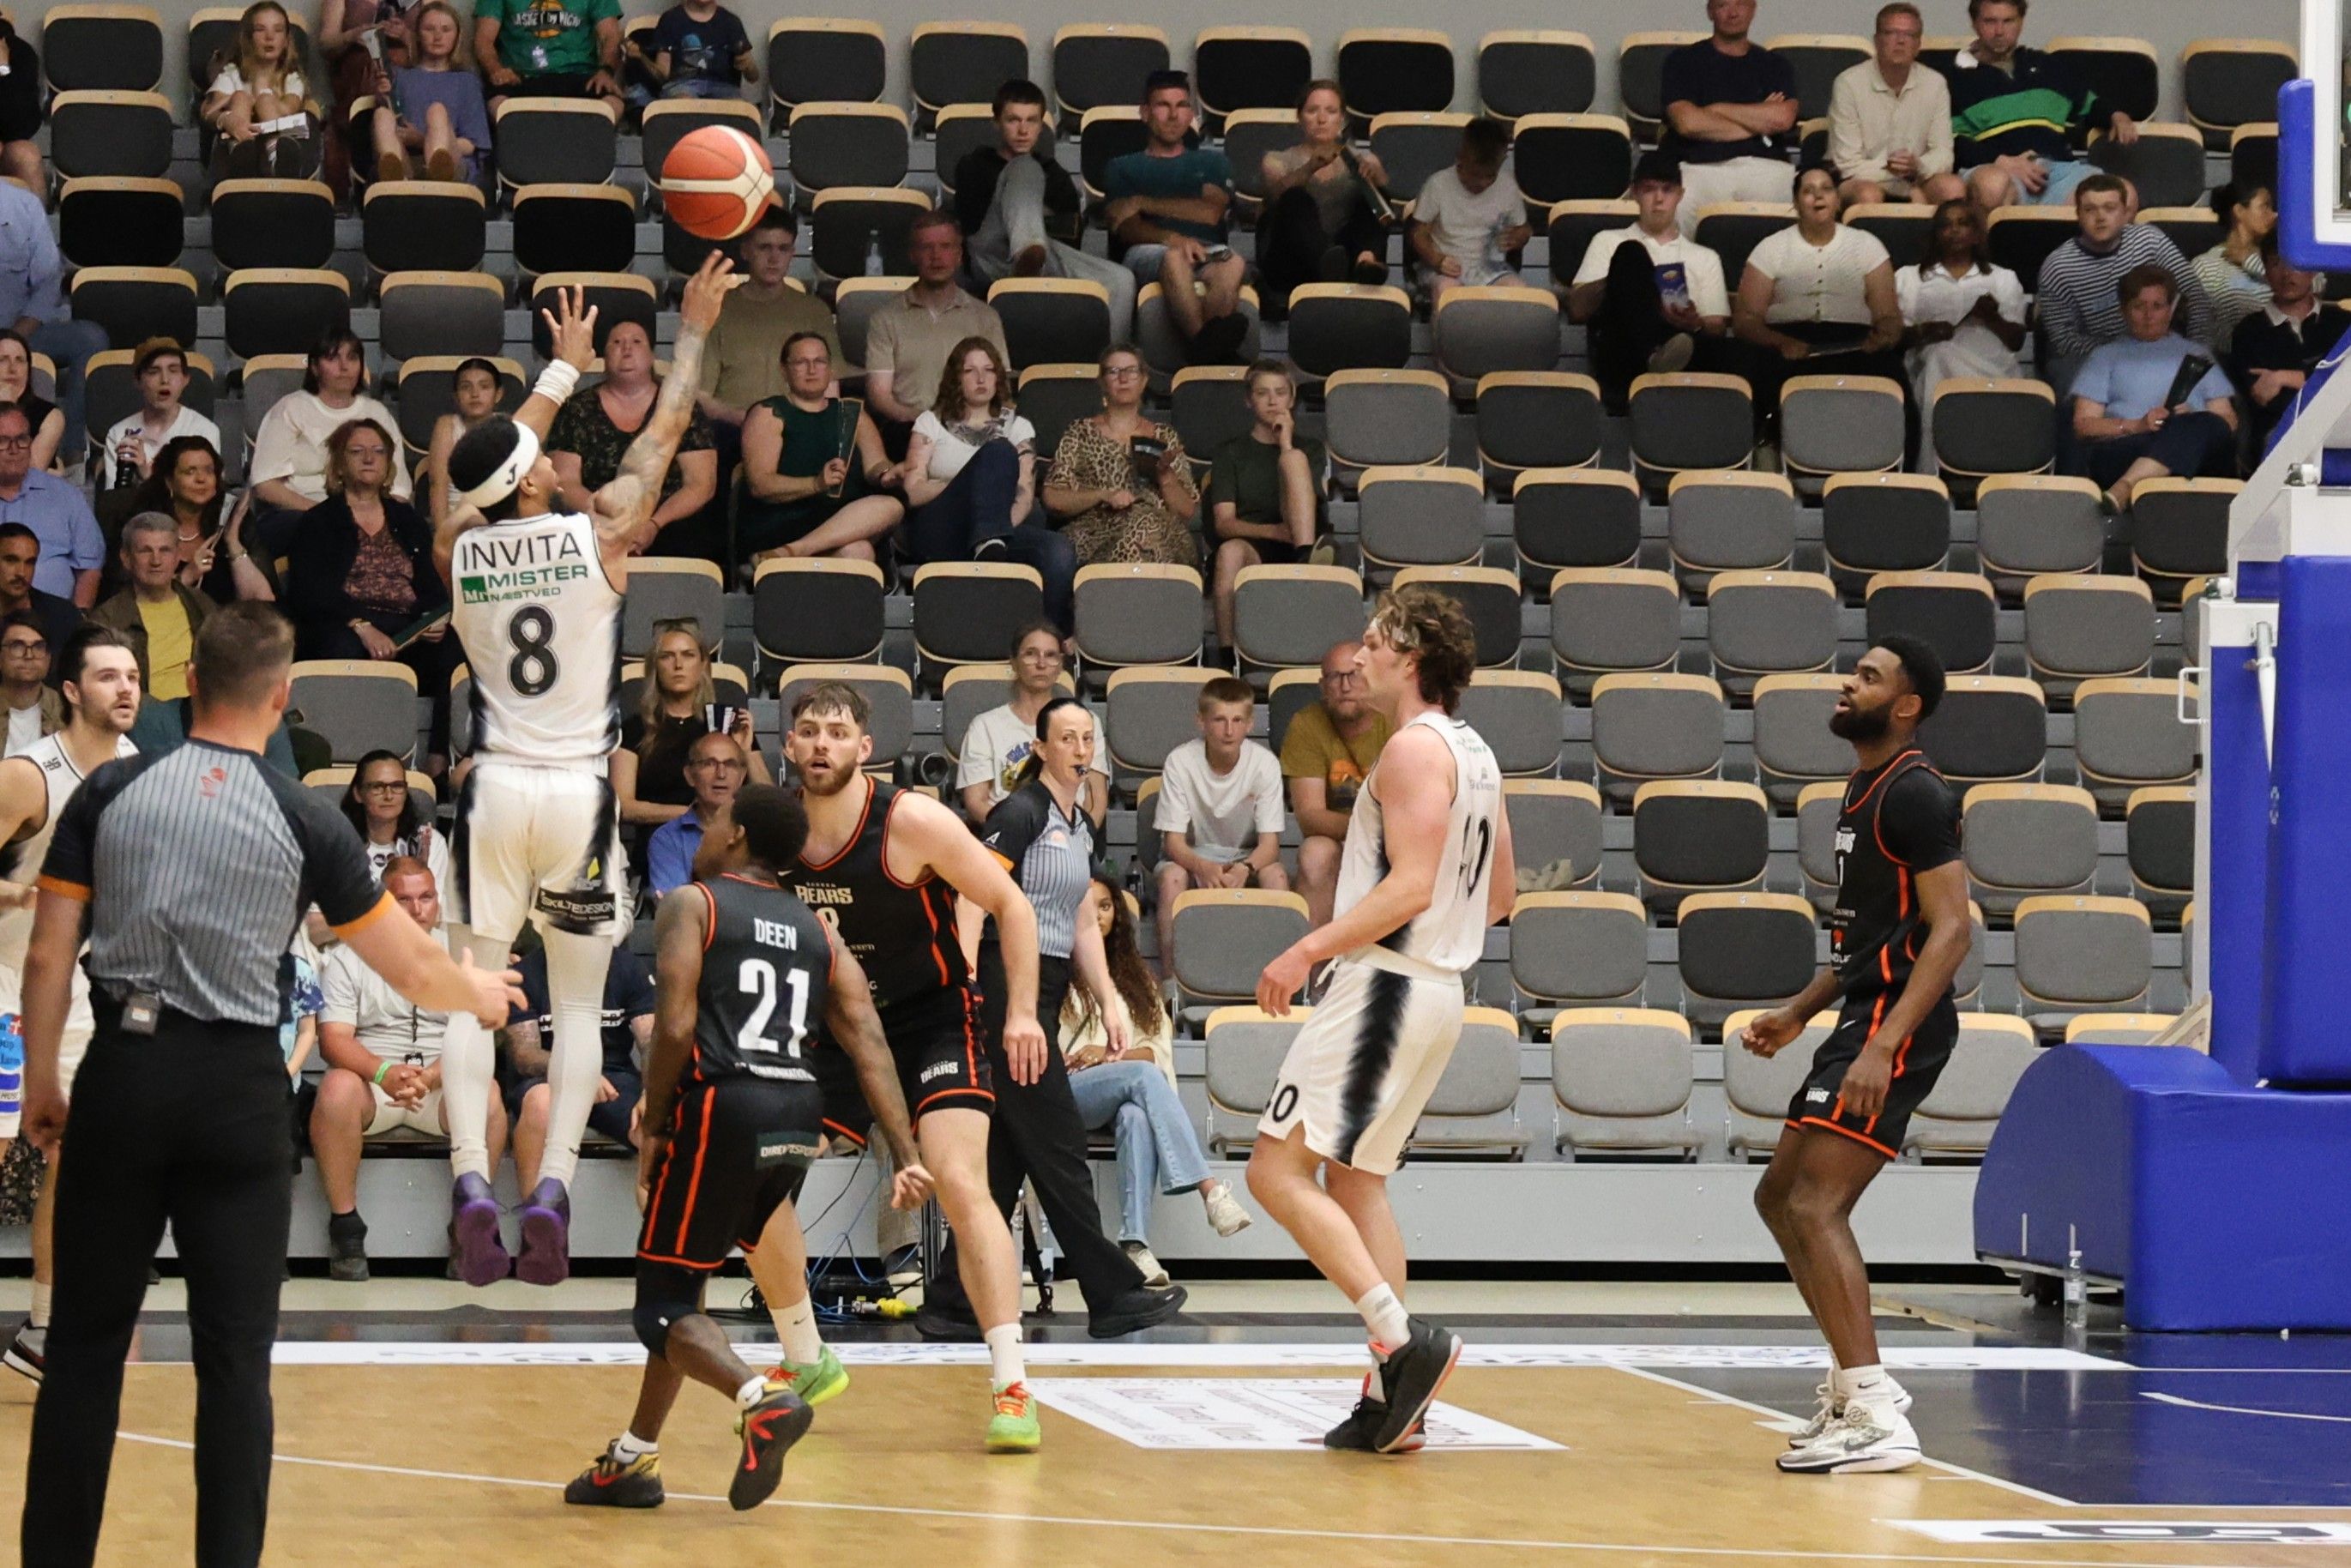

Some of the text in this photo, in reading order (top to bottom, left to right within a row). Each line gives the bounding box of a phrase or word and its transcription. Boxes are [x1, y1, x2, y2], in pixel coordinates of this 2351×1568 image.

[462, 532, 582, 572] INVITA
[487, 564, 589, 589] MISTER
[490, 587, 562, 603] NÆSTVED
[507, 602, 560, 698] 8
[794, 884, 854, 905] BEARS
[754, 917, 798, 951] DEEN
[738, 957, 811, 1059] 21
